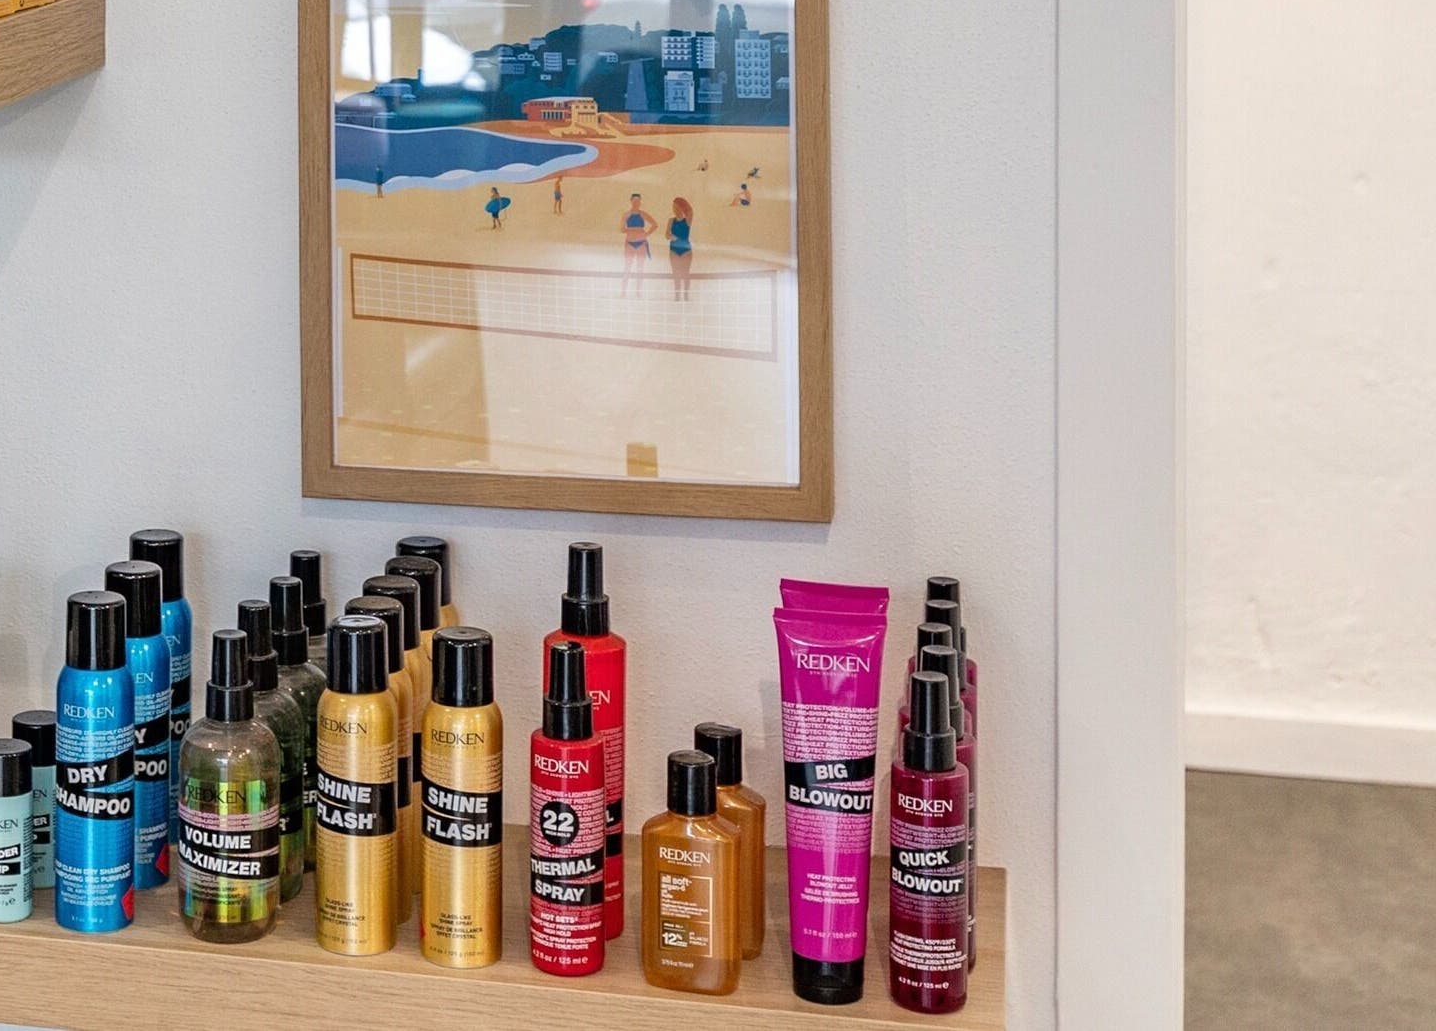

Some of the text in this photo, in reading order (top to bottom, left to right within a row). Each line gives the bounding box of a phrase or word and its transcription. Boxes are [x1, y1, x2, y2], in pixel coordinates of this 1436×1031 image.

[796, 653, 871, 673] REDKEN
[63, 703, 115, 720] REDKEN
[319, 716, 367, 734] REDKEN
[430, 729, 485, 746] REDKEN
[66, 764, 108, 784] DRY
[534, 753, 589, 774] REDKEN
[815, 763, 848, 780] BIG
[186, 786, 248, 805] REDKEN
[317, 771, 371, 805] SHINE
[789, 784, 873, 811] BLOWOUT
[427, 786, 488, 813] SHINE
[898, 792, 954, 814] REDKEN
[316, 804, 373, 830] FLASH
[542, 808, 574, 833] 22
[184, 824, 252, 850] VOLUME
[426, 816, 490, 842] FLASH
[179, 839, 261, 876] MAXIMIZER
[658, 845, 711, 865] REDKEN
[899, 850, 950, 867] QUICK
[531, 857, 596, 876] THERMAL
[891, 866, 963, 893] BLOWOUT
[535, 881, 585, 902] SPRAY
